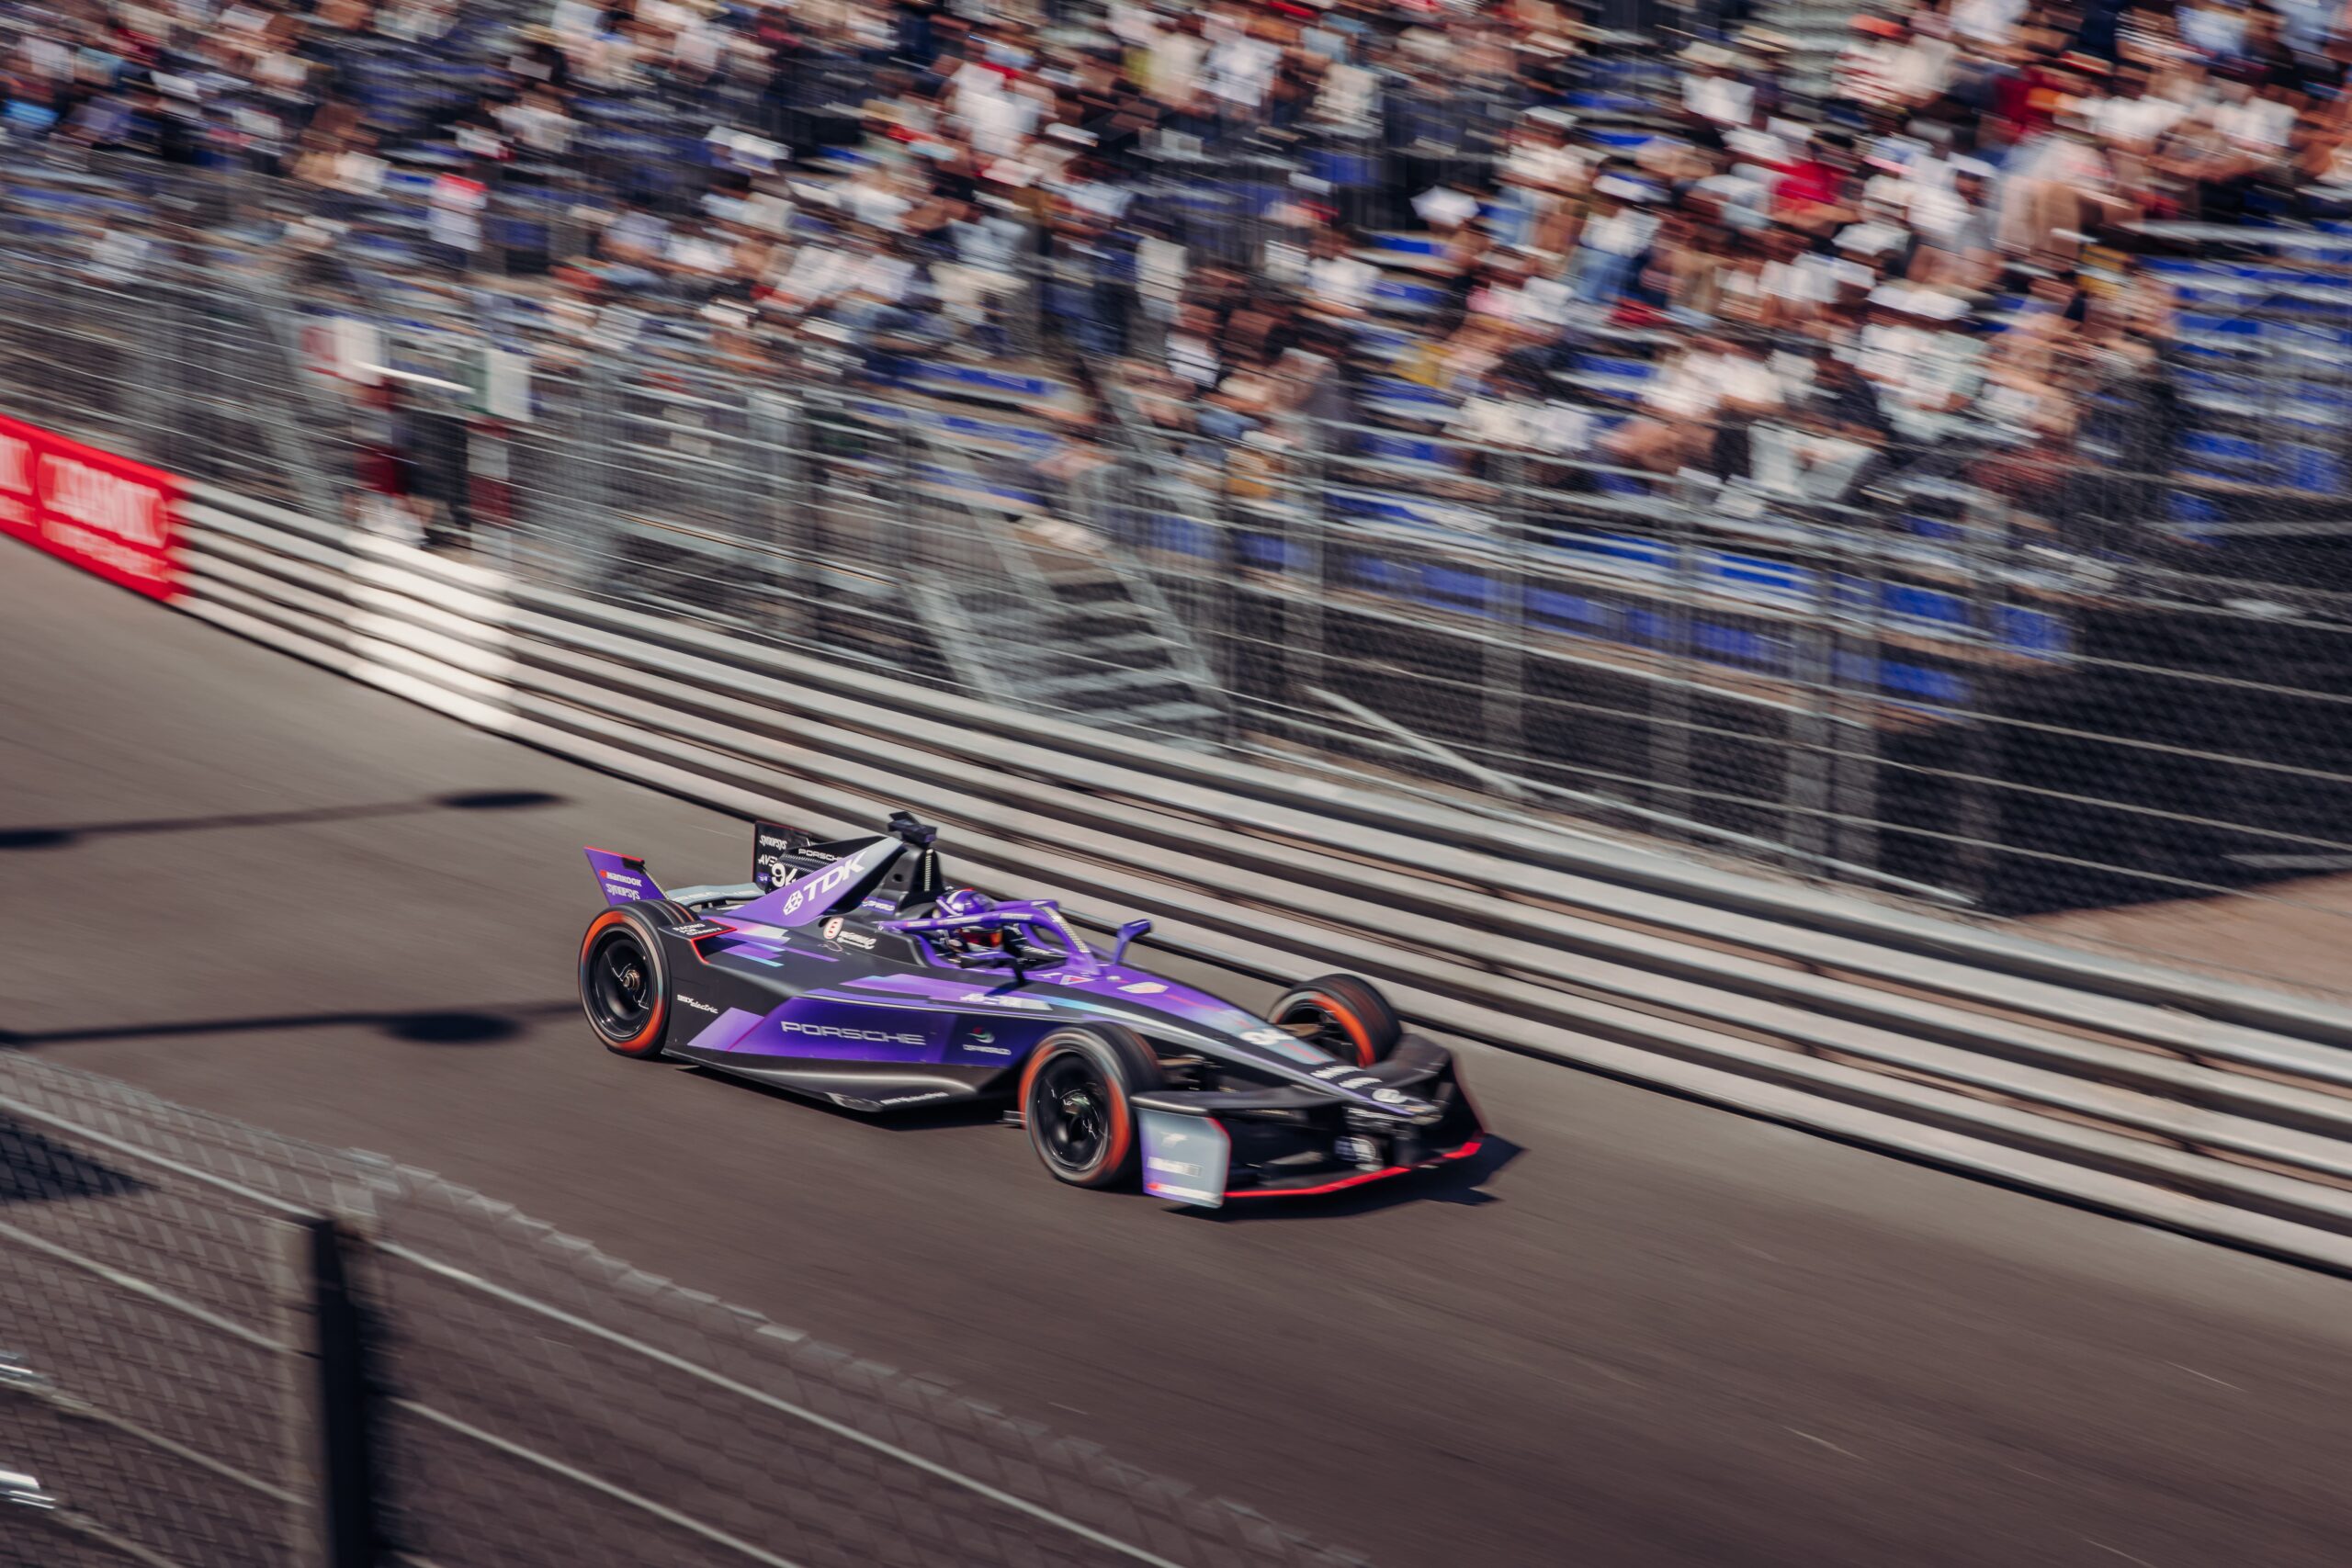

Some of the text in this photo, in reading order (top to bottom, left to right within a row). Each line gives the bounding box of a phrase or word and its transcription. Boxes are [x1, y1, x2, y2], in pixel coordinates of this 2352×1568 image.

[759, 834, 788, 852] SYNOPSYS
[803, 851, 866, 902] TDK
[605, 883, 640, 901] SYNOPSYS
[780, 1021, 927, 1045] PORSCHE
